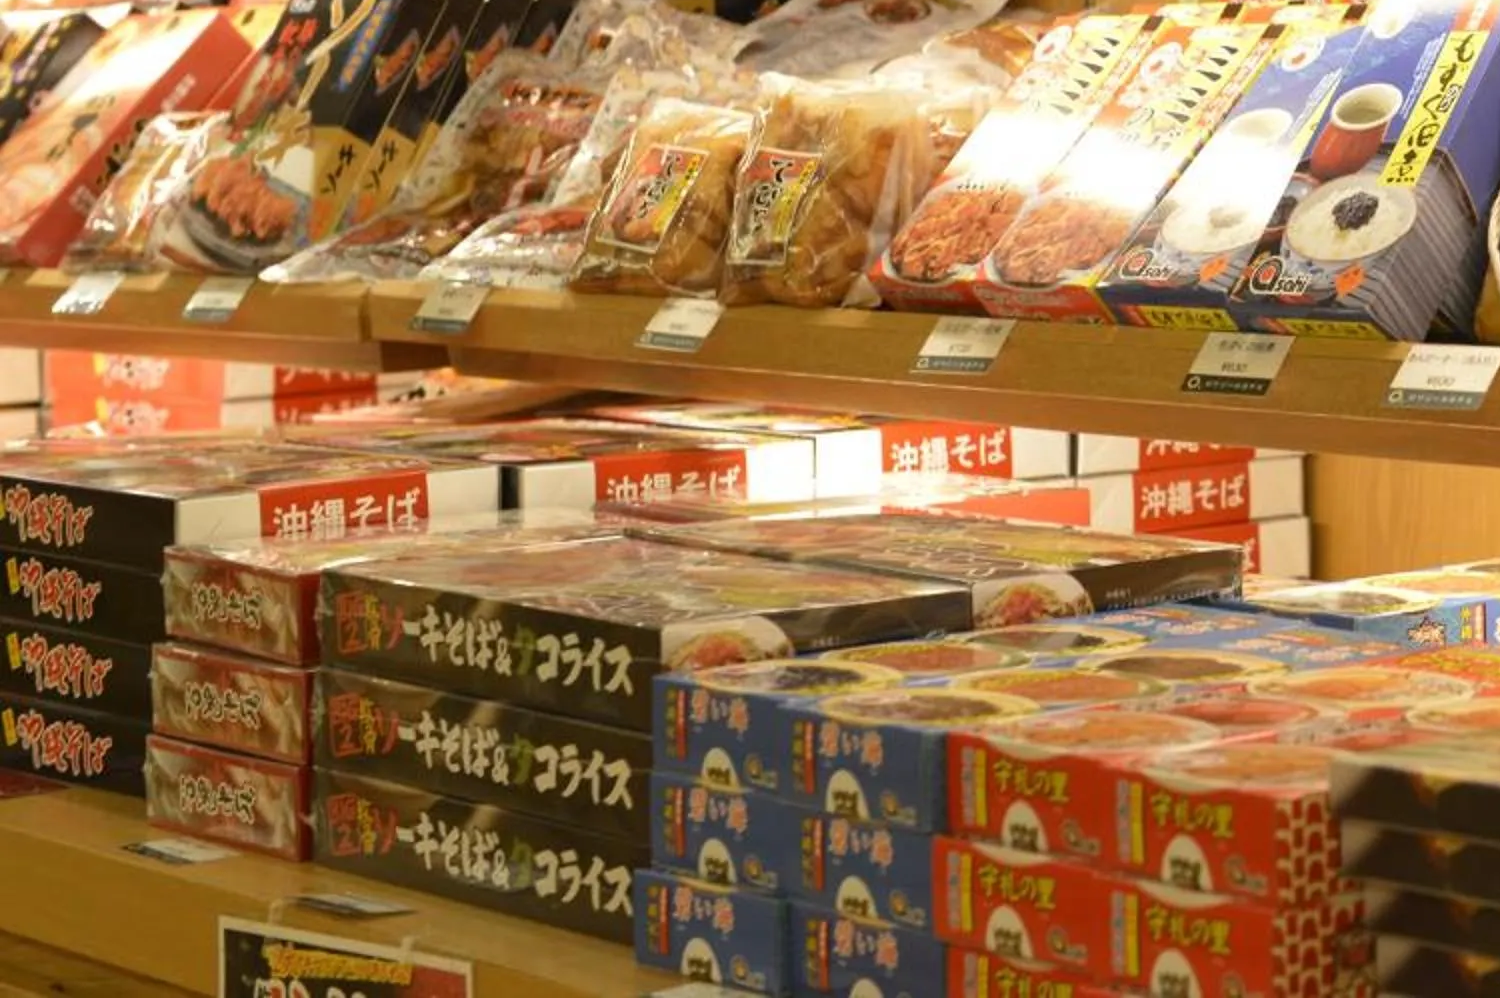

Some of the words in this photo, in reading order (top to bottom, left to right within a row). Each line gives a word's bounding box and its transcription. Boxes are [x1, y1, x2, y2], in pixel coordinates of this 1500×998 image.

[890, 432, 1010, 475] 沖縄そば
[606, 464, 744, 503] 沖縄そば
[1140, 478, 1249, 521] 沖縄そば
[272, 488, 424, 538] 沖縄そば
